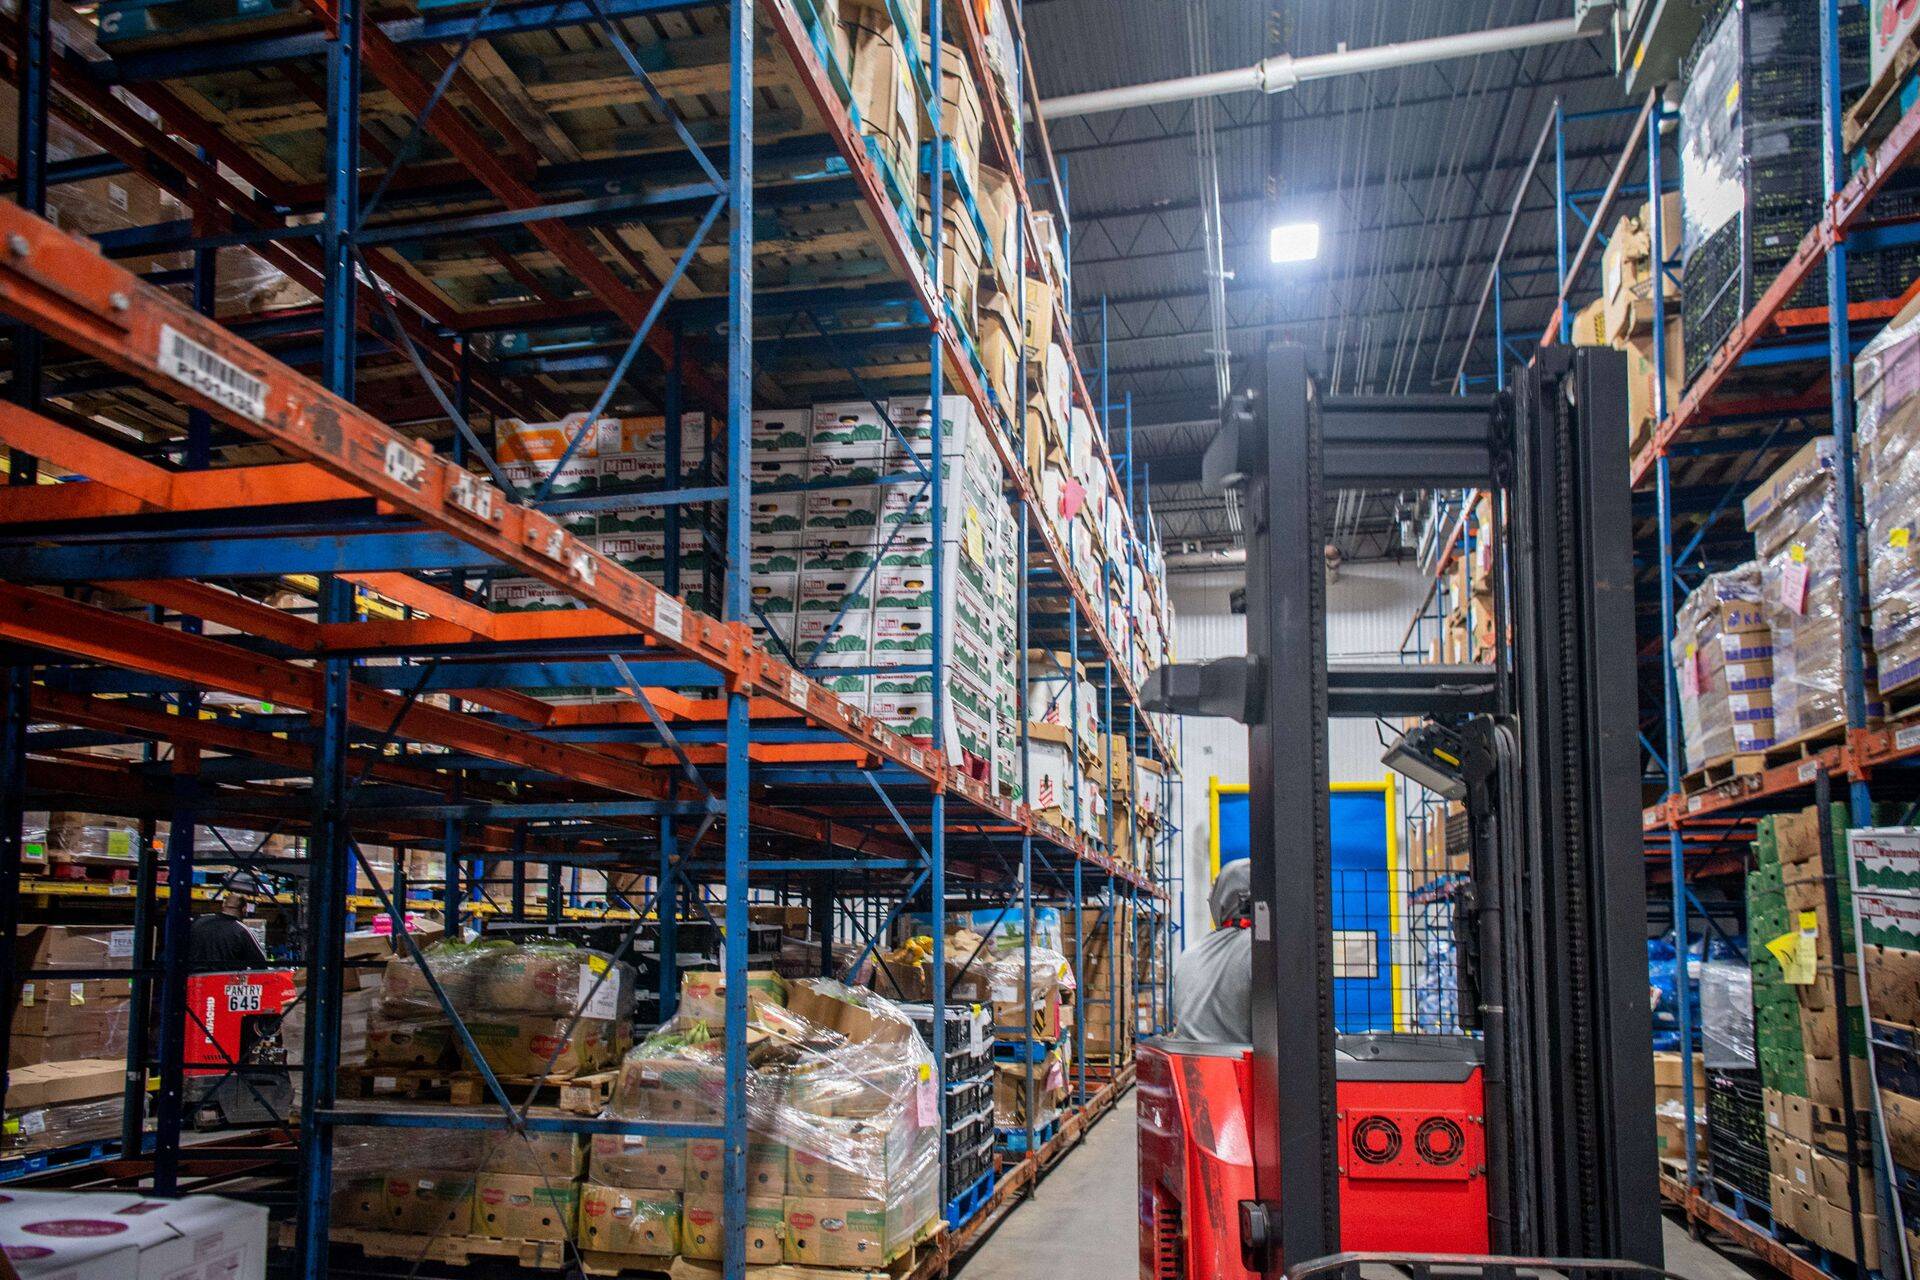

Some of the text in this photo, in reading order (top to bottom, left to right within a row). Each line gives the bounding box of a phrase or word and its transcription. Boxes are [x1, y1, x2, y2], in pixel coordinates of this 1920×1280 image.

[604, 457, 637, 473] Mini
[603, 540, 637, 553] Mini
[494, 585, 528, 600] Mini
[1852, 839, 1878, 858] Mini
[1858, 897, 1888, 917] Mini
[225, 985, 262, 996] PANTRY
[229, 996, 259, 1011] 645
